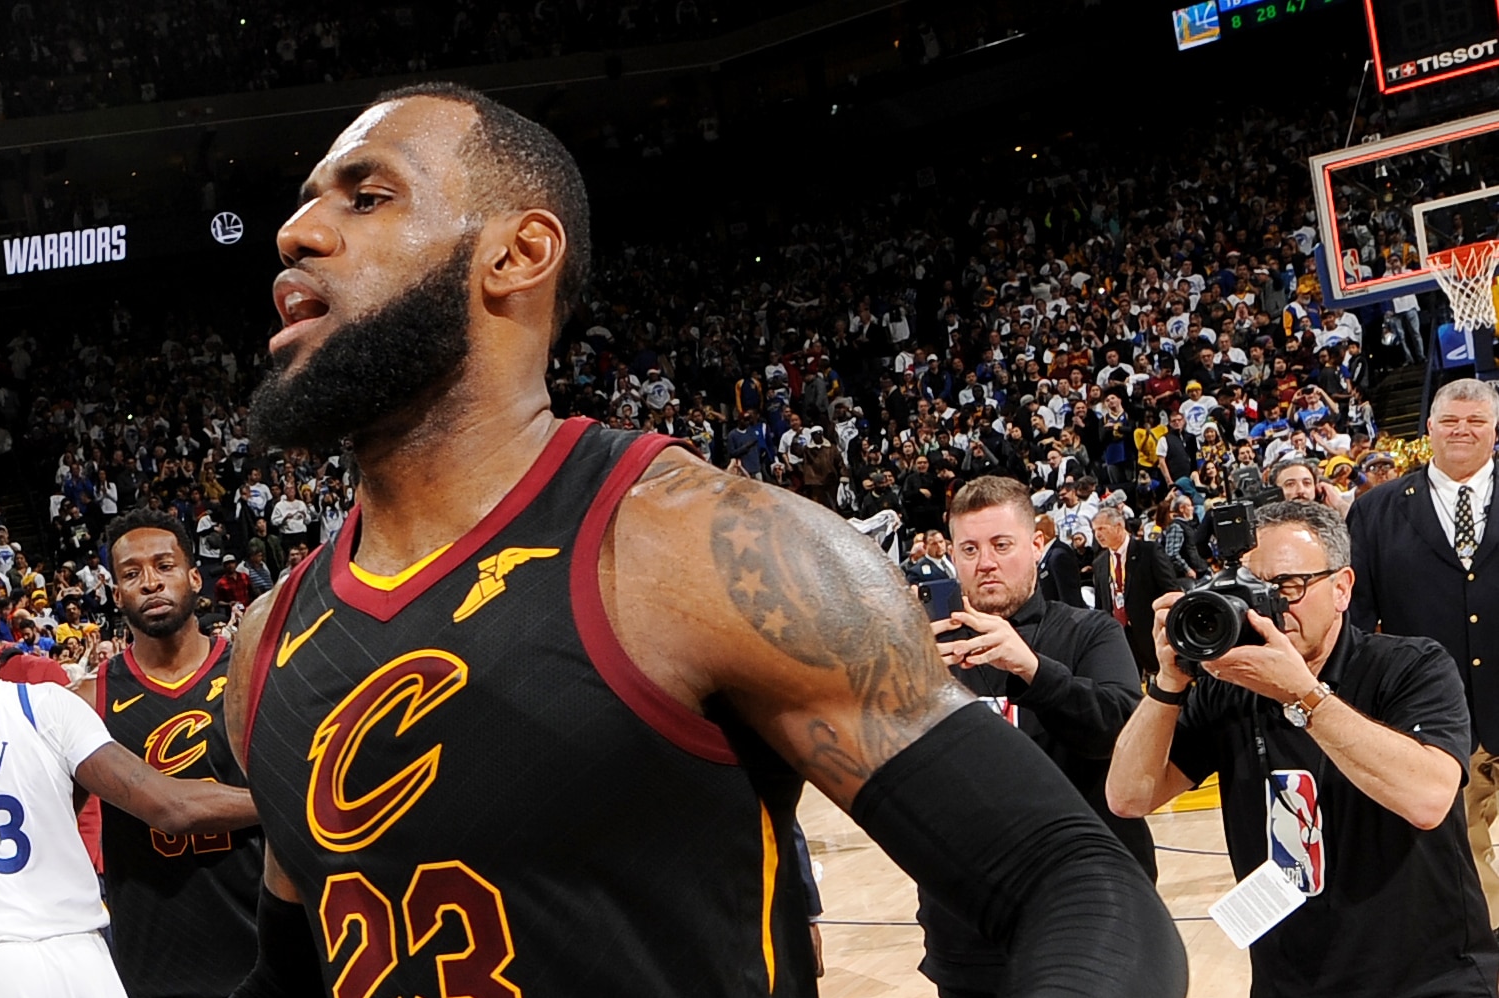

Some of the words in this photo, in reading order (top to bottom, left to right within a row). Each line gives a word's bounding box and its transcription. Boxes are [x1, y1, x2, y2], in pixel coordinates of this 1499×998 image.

[1256, 5, 1277, 22] 28
[1416, 39, 1498, 73] TISSOT
[3, 224, 127, 275] WARRIORS
